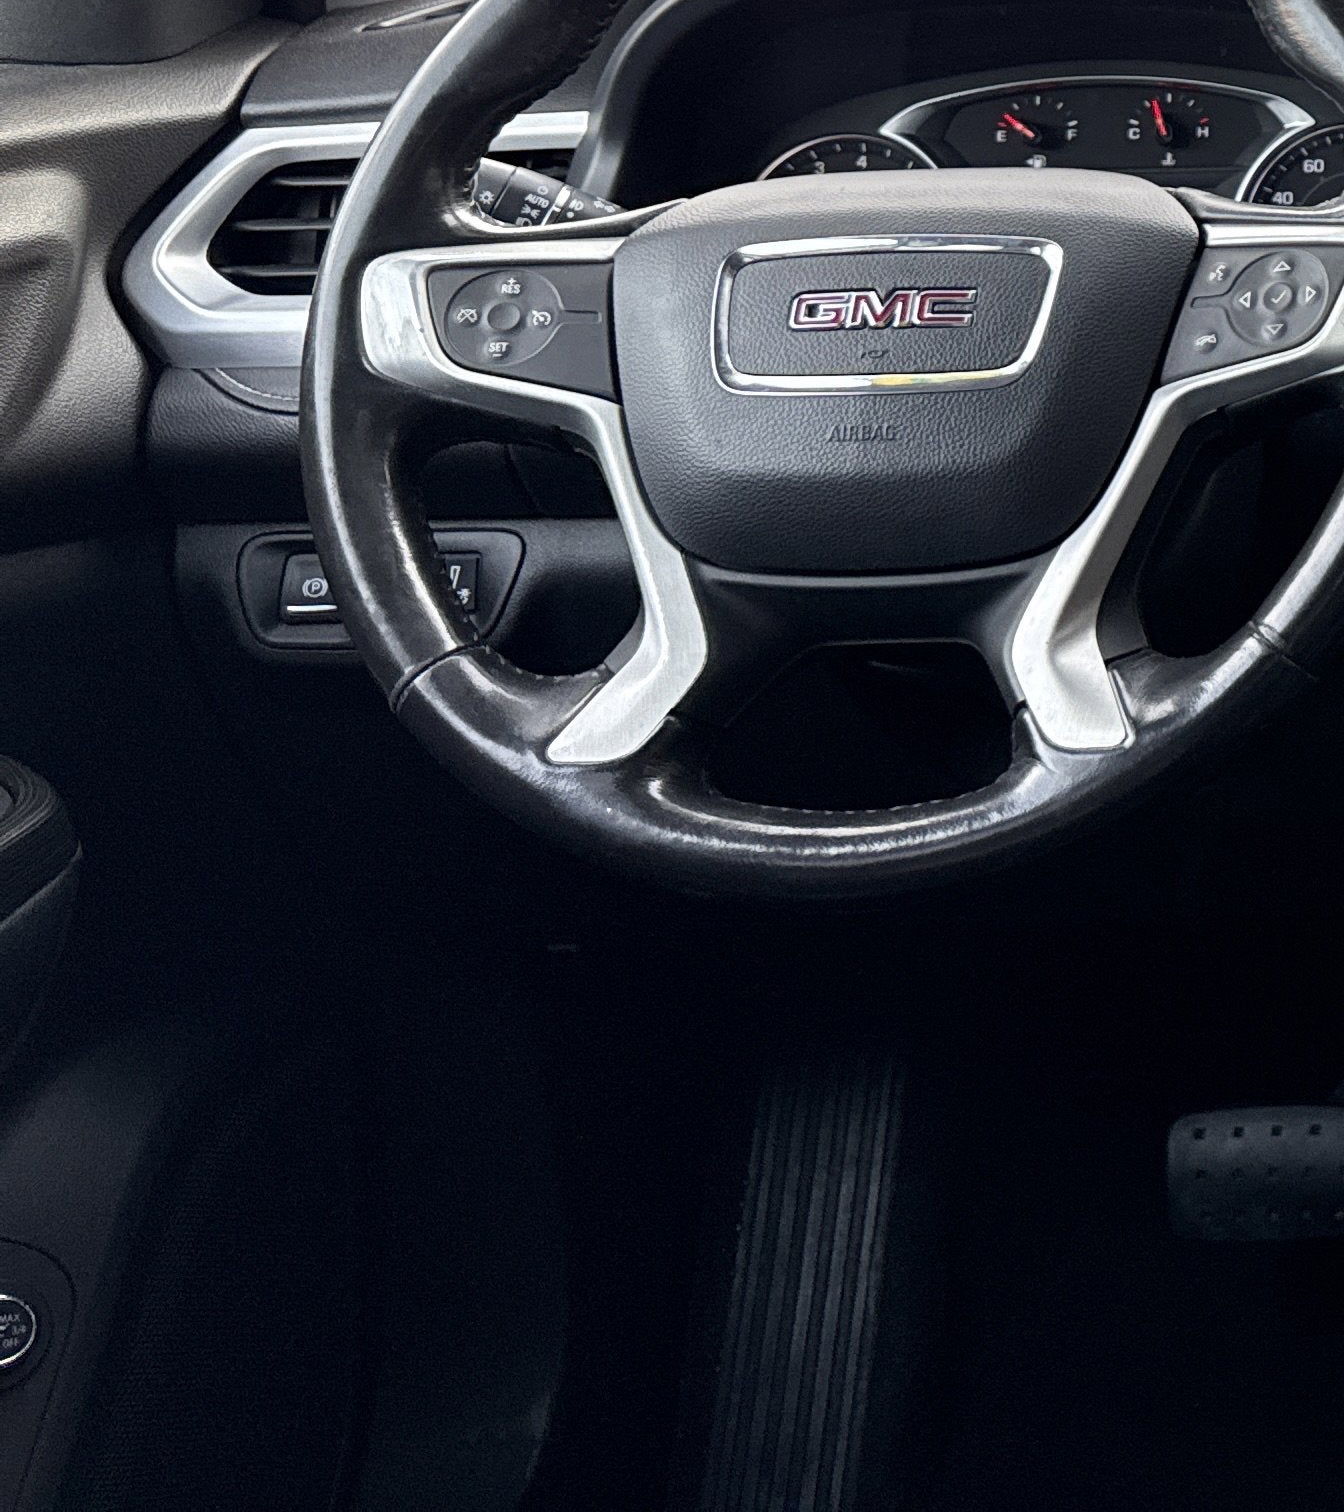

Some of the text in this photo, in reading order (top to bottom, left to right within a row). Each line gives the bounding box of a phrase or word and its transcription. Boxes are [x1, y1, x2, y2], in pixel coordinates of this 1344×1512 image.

[997, 131, 1007, 143] E
[1066, 129, 1078, 141] F
[1127, 128, 1140, 140] C
[1197, 126, 1209, 138] H
[856, 156, 868, 169] 4
[1303, 158, 1325, 173] 60
[524, 193, 550, 209] AUTO
[1272, 191, 1294, 205] 40
[501, 284, 521, 295] RES
[788, 288, 978, 332] GMC
[488, 342, 510, 353] SET
[827, 424, 904, 443] AIRBAG
